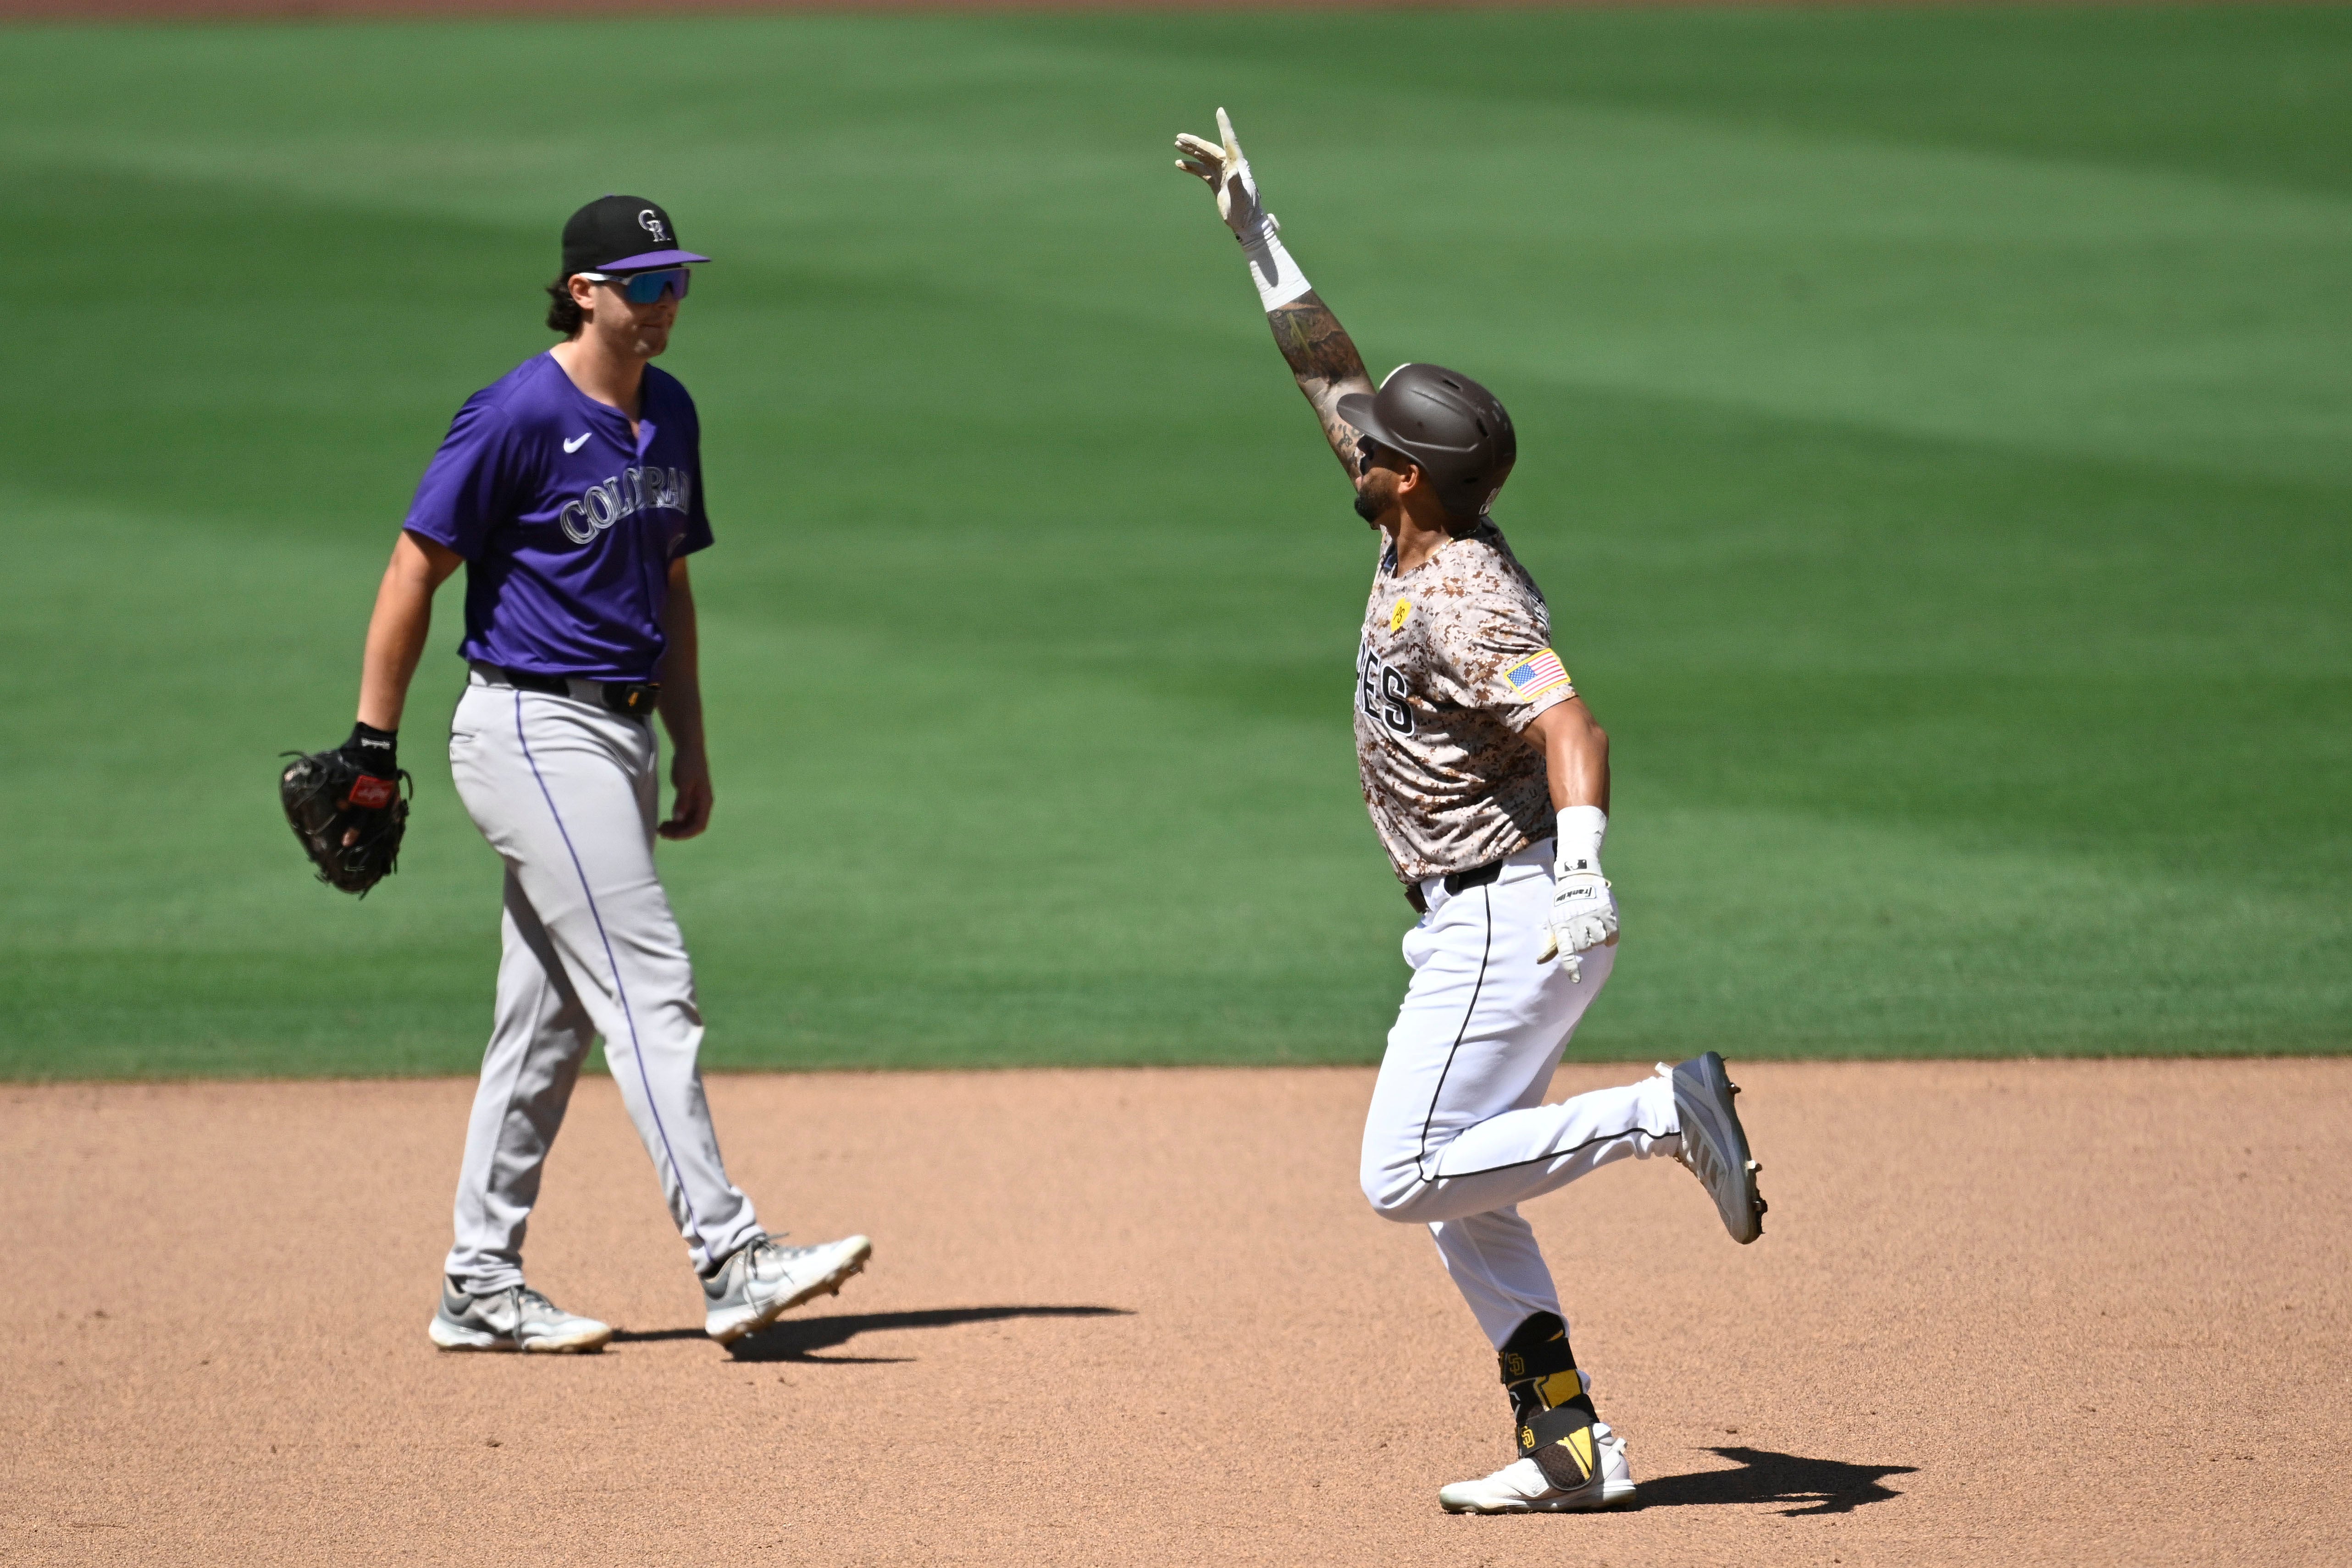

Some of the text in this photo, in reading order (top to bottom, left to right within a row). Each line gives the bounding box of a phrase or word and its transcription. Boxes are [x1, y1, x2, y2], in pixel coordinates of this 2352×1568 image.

[1393, 606, 1405, 624] PS
[1356, 635, 1415, 737] ES
[1508, 1353, 1525, 1376] SD
[1521, 1425, 1535, 1448] SD
